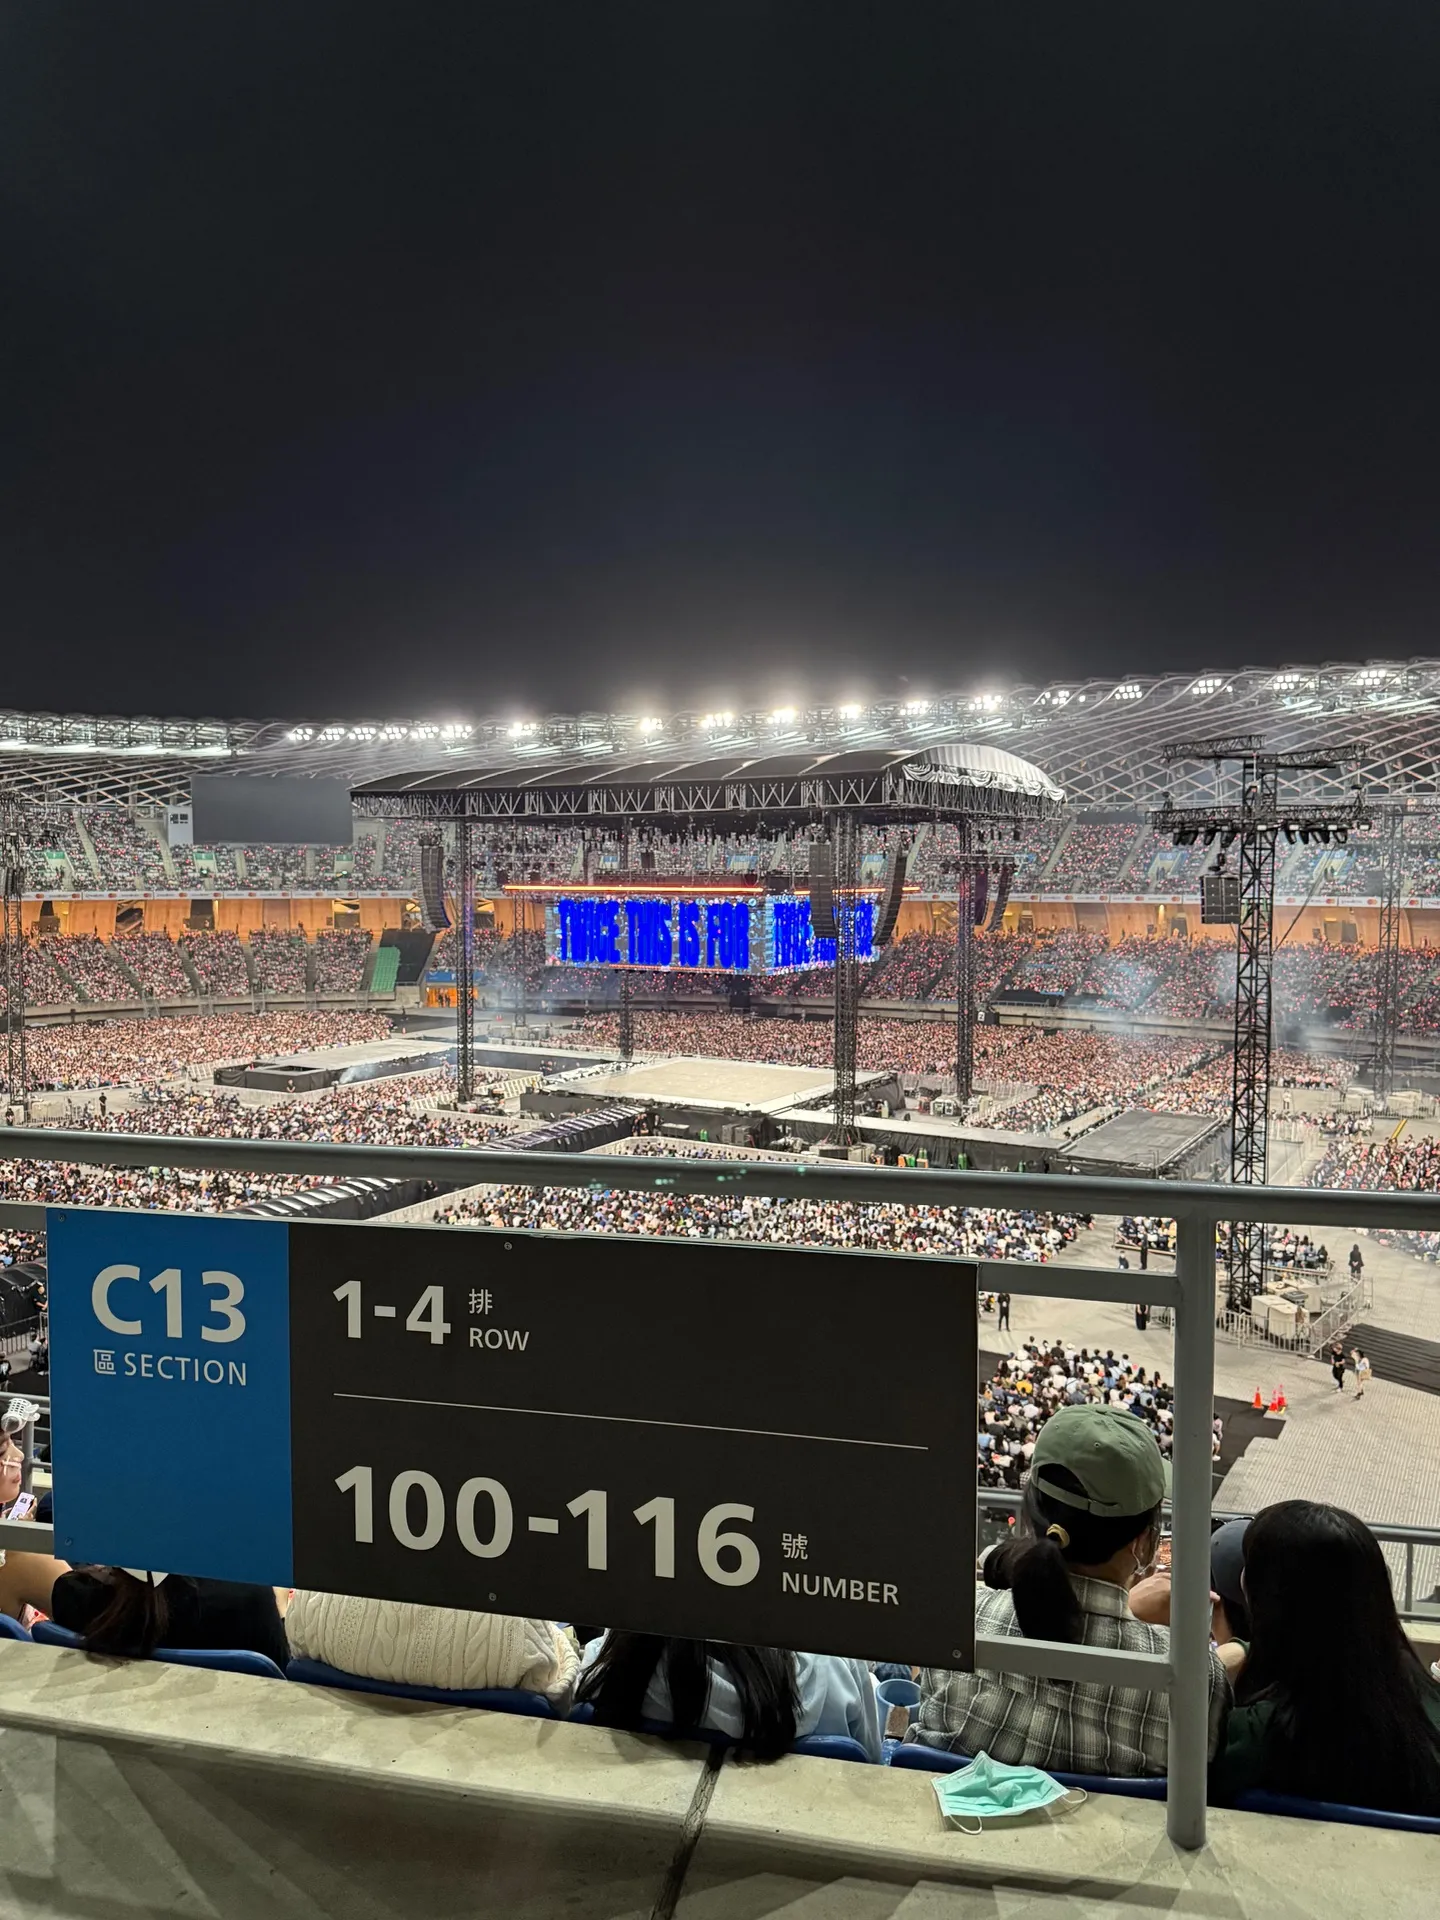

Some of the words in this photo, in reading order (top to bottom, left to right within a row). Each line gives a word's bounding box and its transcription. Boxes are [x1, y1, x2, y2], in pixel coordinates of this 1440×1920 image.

[625, 901, 674, 966] THIS
[679, 902, 700, 967] IS
[707, 903, 749, 969] FOR
[92, 1263, 247, 1343] C13
[333, 1280, 451, 1345] 1-4
[468, 1288, 494, 1316] 排
[468, 1327, 530, 1352] ROW
[93, 1349, 117, 1375] 區
[124, 1352, 247, 1386] SECTION
[334, 1465, 761, 1588] 100-116
[781, 1533, 809, 1561] 號
[782, 1572, 900, 1606] NUMBER
